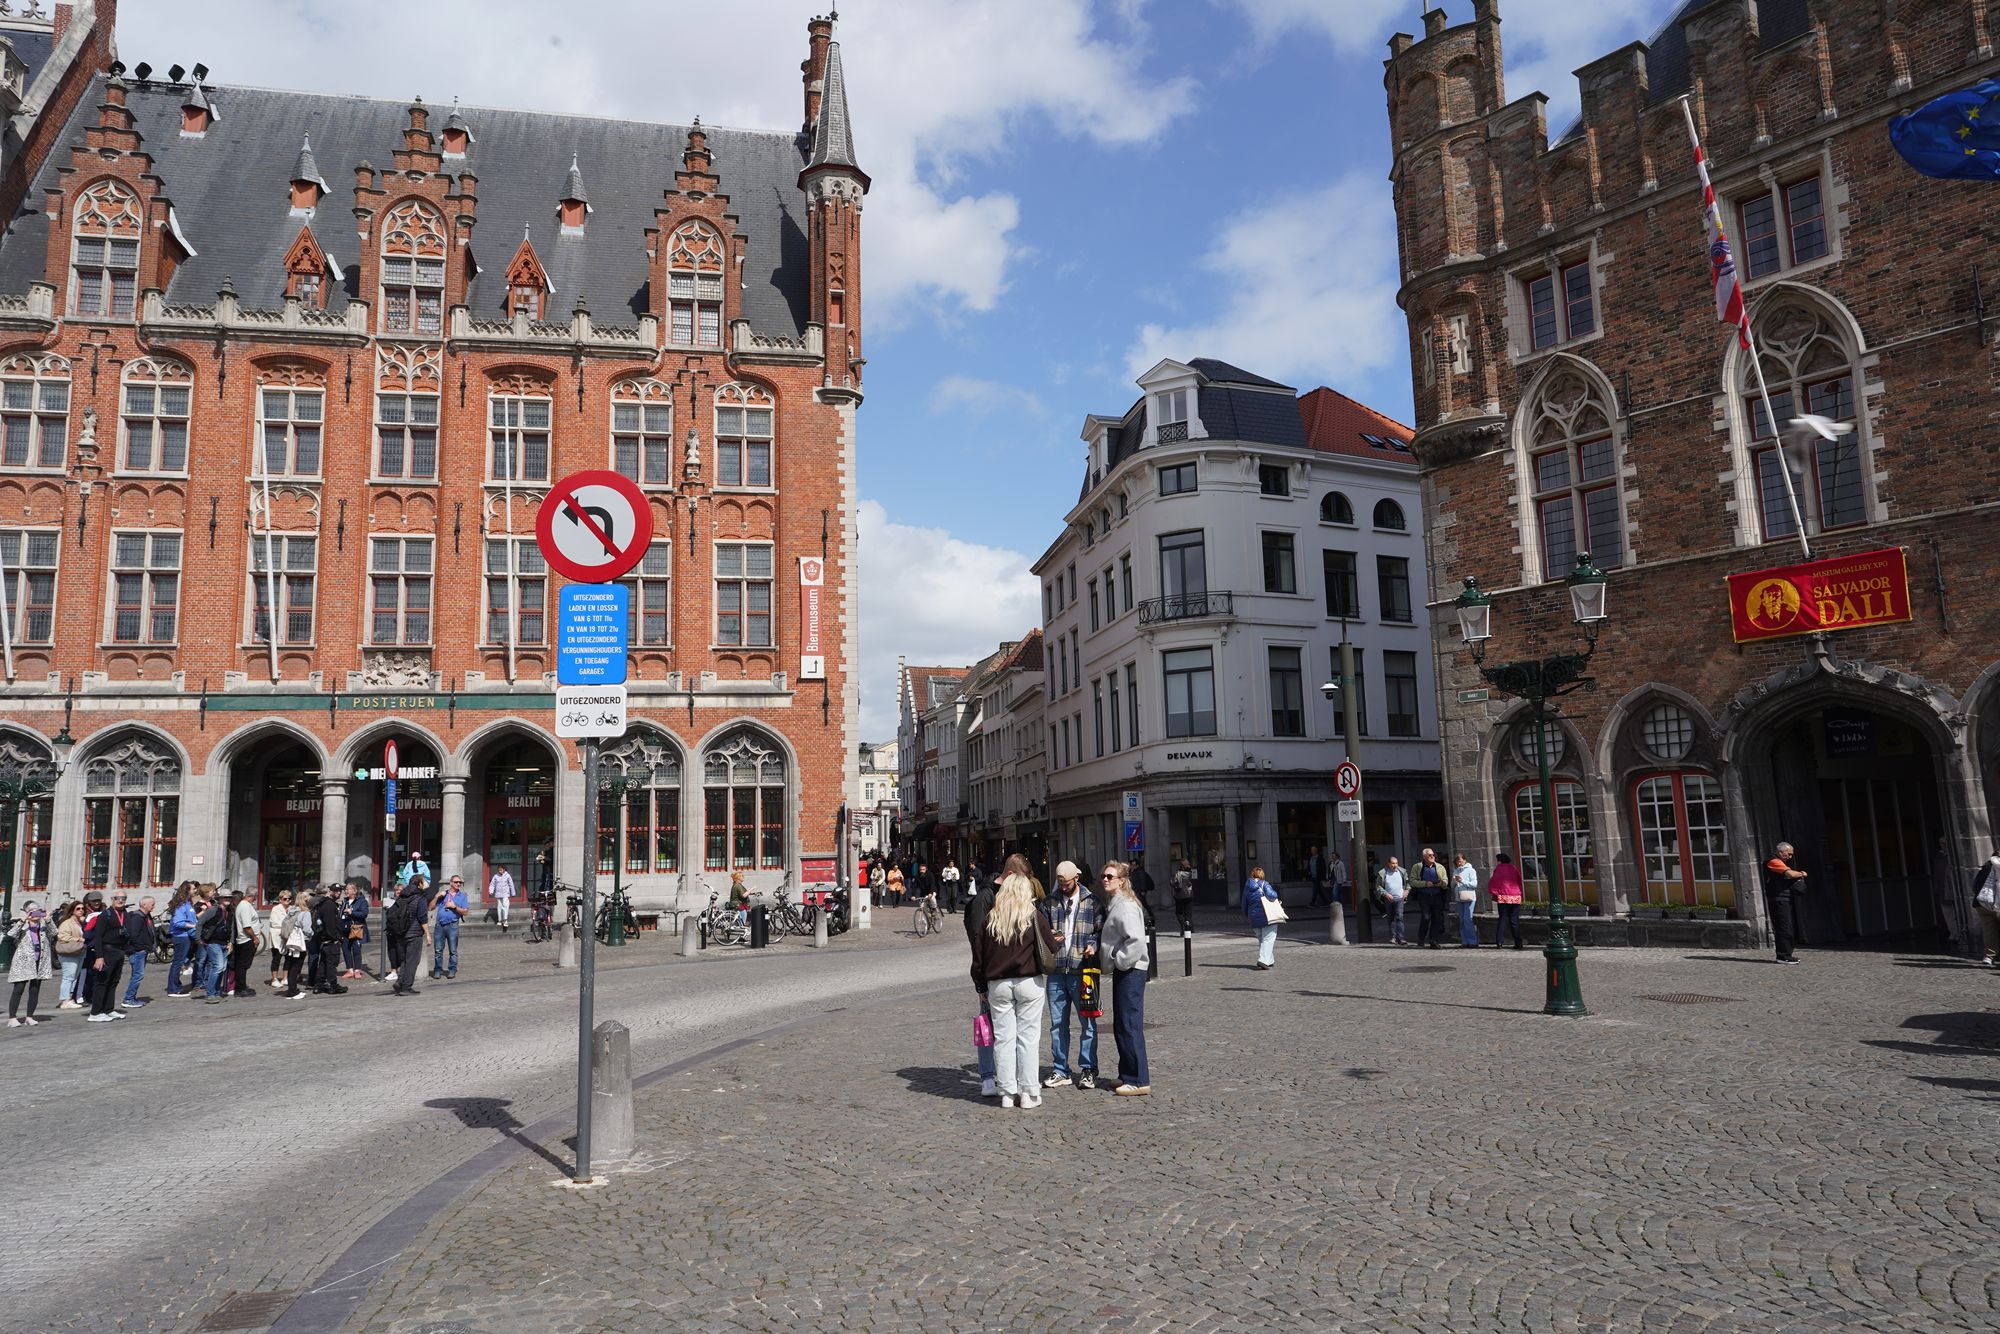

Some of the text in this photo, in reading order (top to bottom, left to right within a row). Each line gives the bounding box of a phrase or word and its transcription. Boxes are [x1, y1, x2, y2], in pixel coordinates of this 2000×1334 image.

[1812, 560, 1888, 578] MUSEUM GALLERY XPO
[1813, 576, 1891, 598] SALVADOR
[568, 604, 619, 612] LADEN EN LOSSEN
[1816, 590, 1896, 625] DALI
[806, 588, 819, 652] Biermuseum
[567, 625, 575, 633] EN
[576, 625, 588, 633] VAN
[589, 625, 596, 633] 19
[597, 625, 608, 633] TOT
[574, 657, 609, 665] EN TOEGANG
[578, 667, 605, 675] GARAGES
[560, 696, 621, 705] UITGEZONDERD
[1167, 751, 1213, 760] DELVAUX
[286, 799, 322, 811] BEAUTY
[395, 798, 441, 810] OW PRICE
[508, 796, 540, 808] HEALTH
